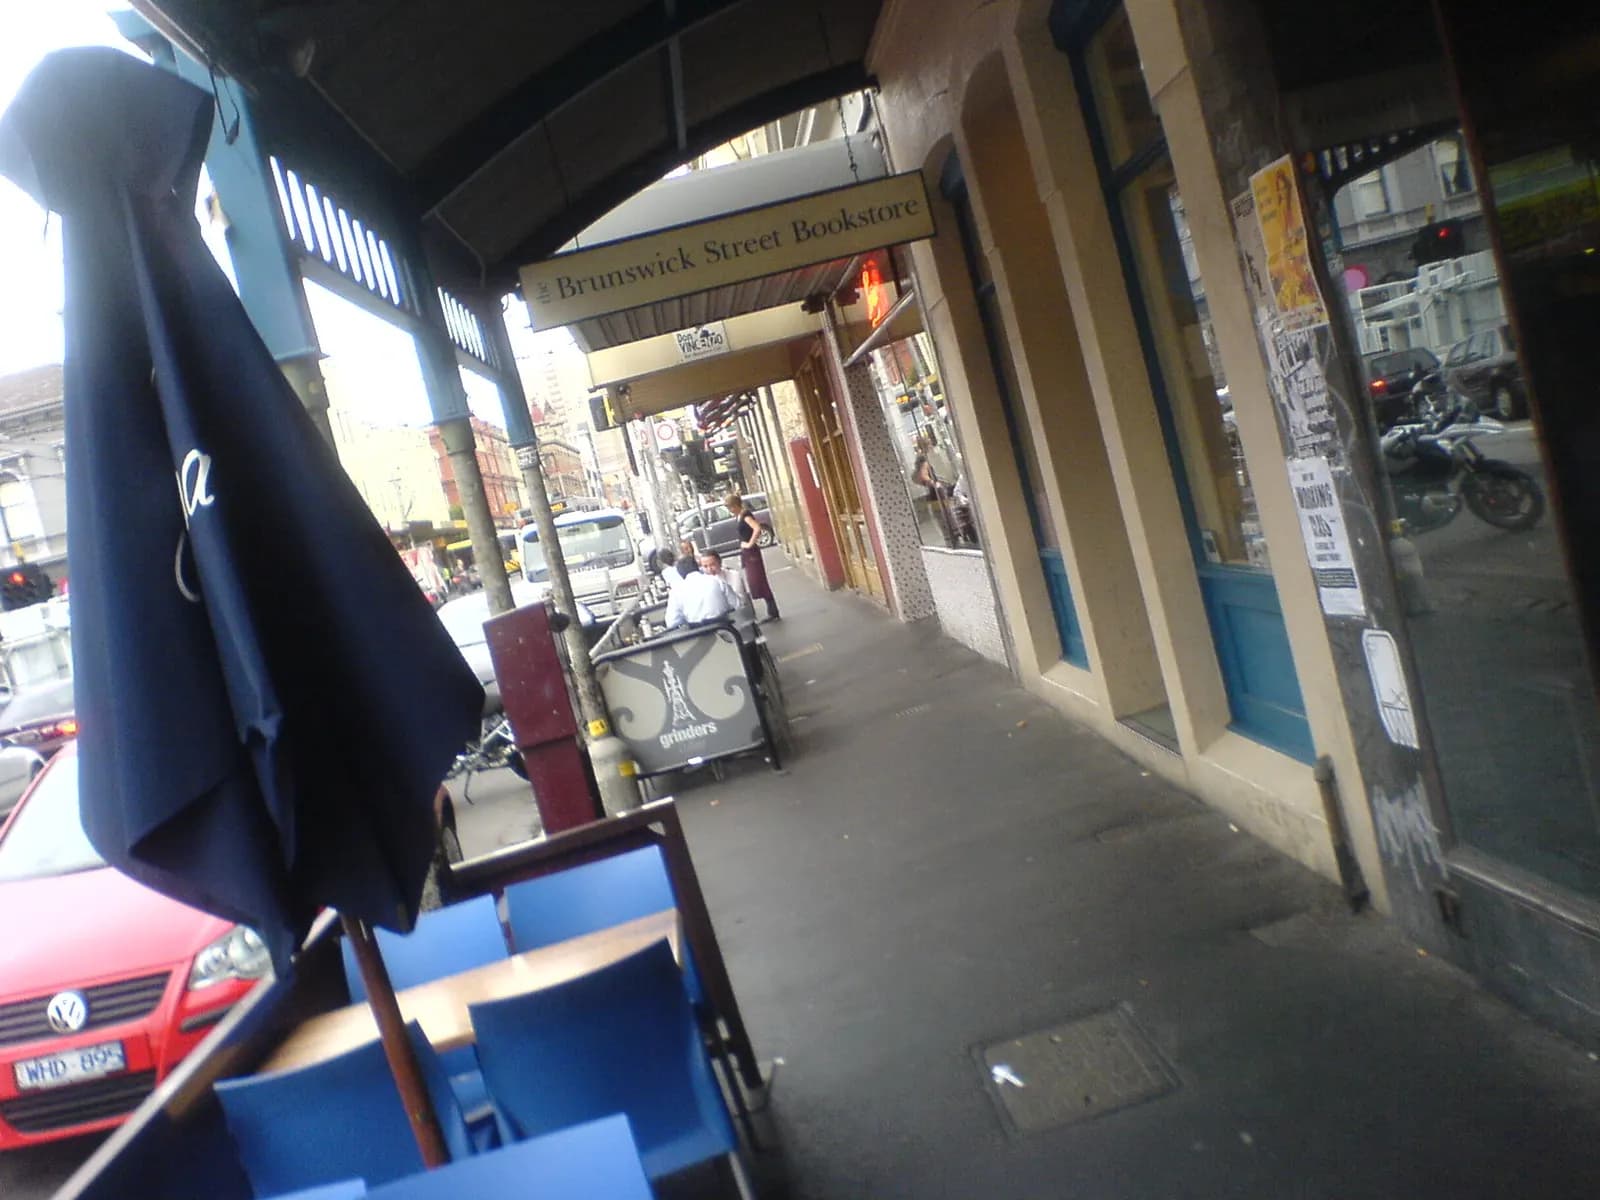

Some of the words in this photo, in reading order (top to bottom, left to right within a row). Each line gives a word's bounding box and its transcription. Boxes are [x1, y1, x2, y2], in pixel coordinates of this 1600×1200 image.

[555, 248, 697, 300] Brunswick
[703, 227, 782, 263] Street
[791, 197, 920, 243] Bookstore
[659, 721, 718, 748] grinders
